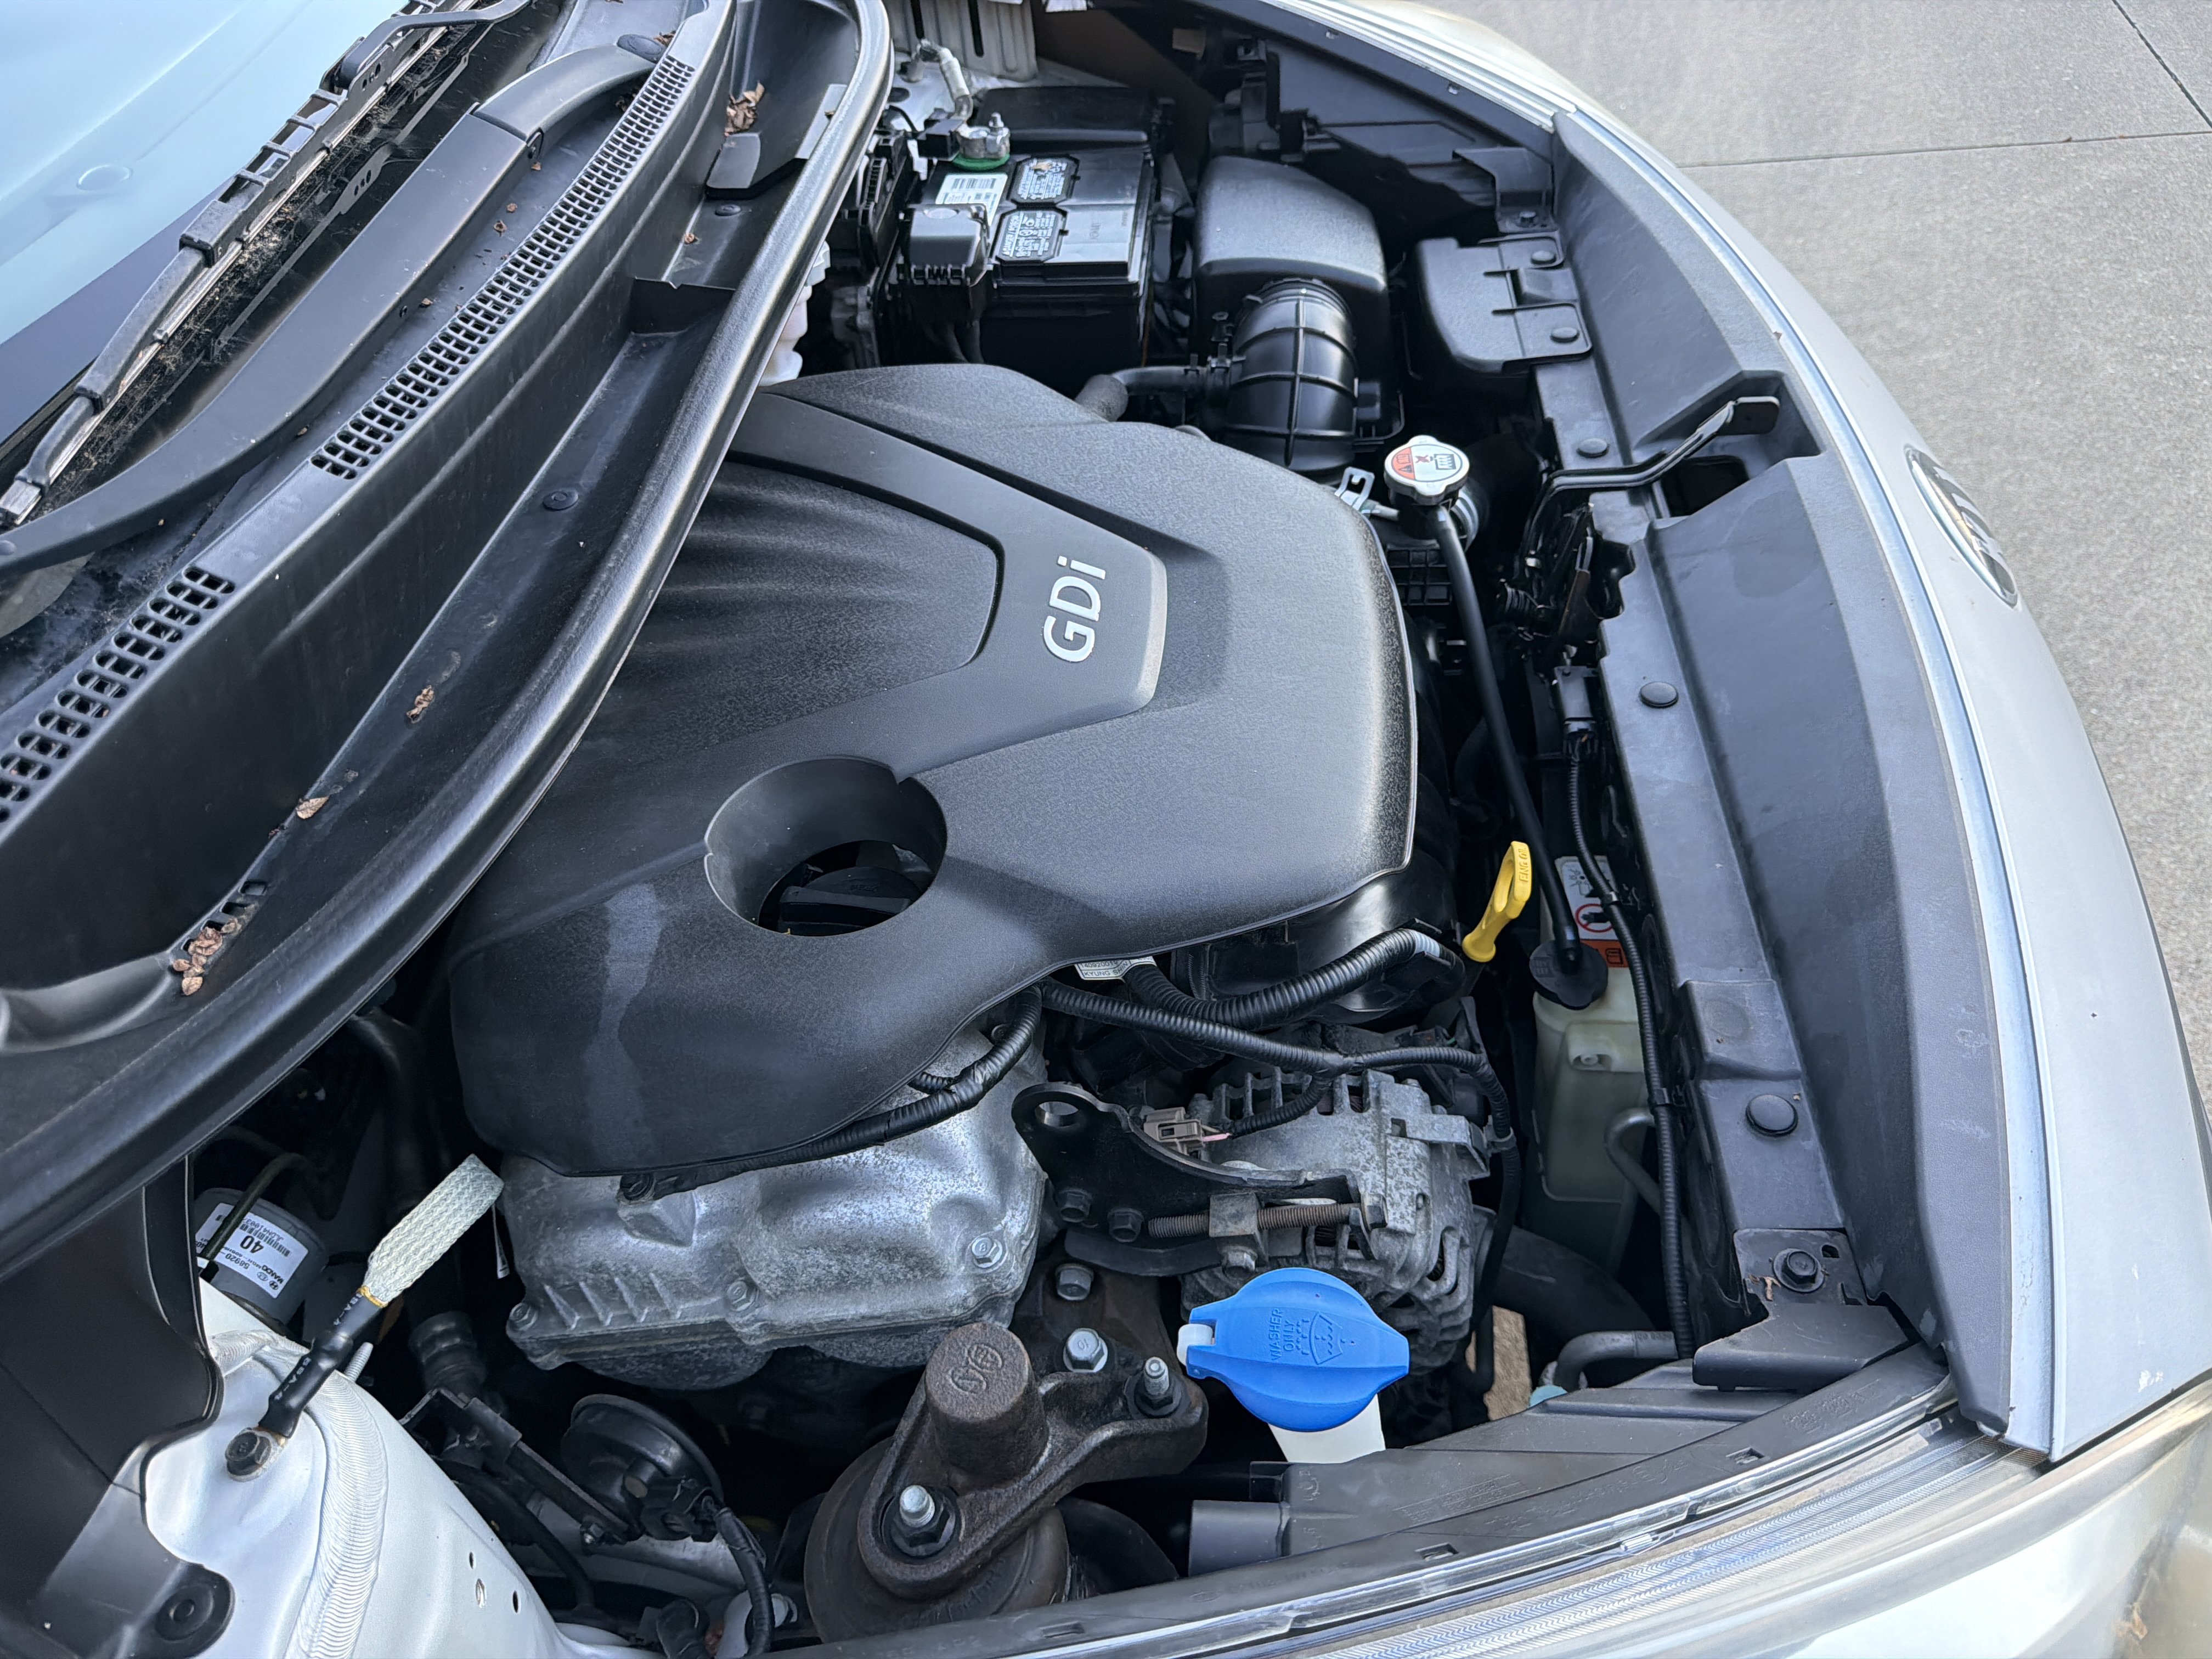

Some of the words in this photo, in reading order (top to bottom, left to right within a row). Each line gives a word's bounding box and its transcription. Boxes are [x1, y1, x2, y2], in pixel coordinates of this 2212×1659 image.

[1043, 555, 1106, 663] GDi
[1519, 861, 1528, 883] ENG
[1112, 961, 1128, 975] SHIN
[240, 1235, 264, 1254] 40
[261, 1265, 284, 1284] MANDO
[1268, 1308, 1283, 1361] WASHER
[1283, 1319, 1295, 1352] ONLY
